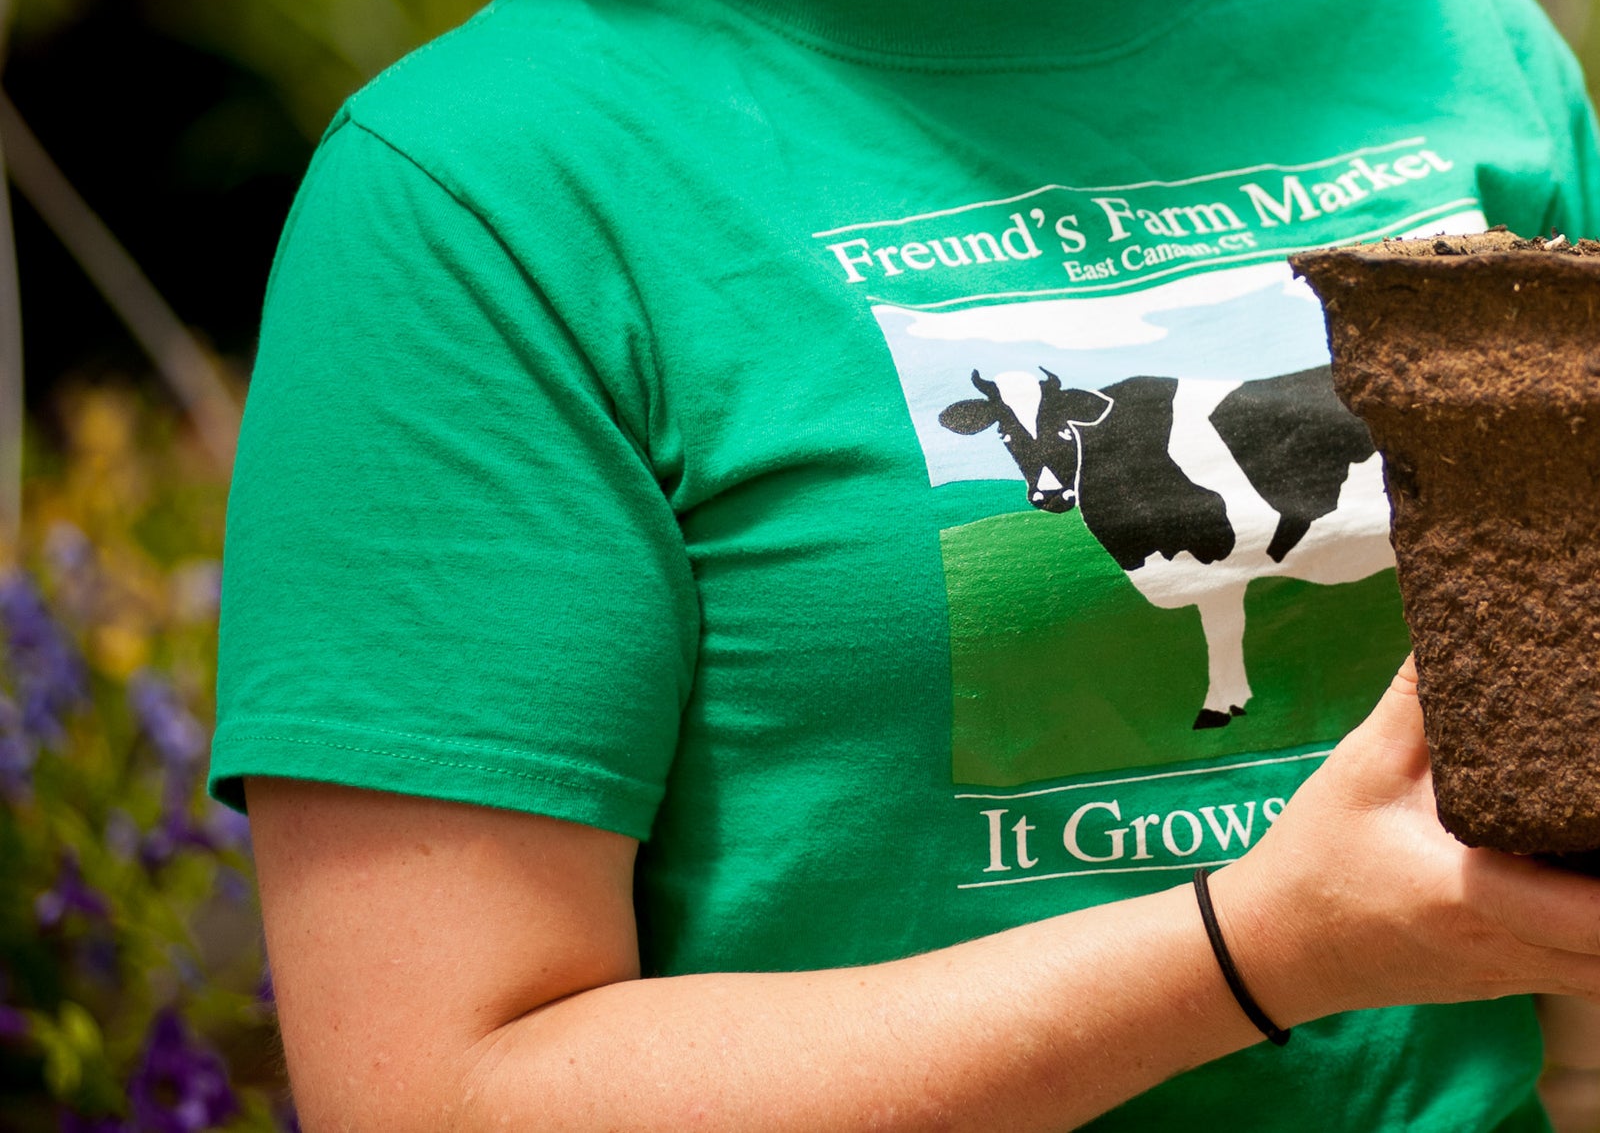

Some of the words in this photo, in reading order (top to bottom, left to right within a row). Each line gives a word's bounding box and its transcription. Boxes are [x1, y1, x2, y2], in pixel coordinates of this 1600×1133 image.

[827, 207, 1088, 284] Freund's
[1091, 196, 1246, 243] Farm
[1241, 149, 1453, 227] Market
[1061, 256, 1120, 283] East
[1120, 241, 1221, 272] Canaan,
[1217, 232, 1258, 250] CT
[981, 808, 1039, 873] It
